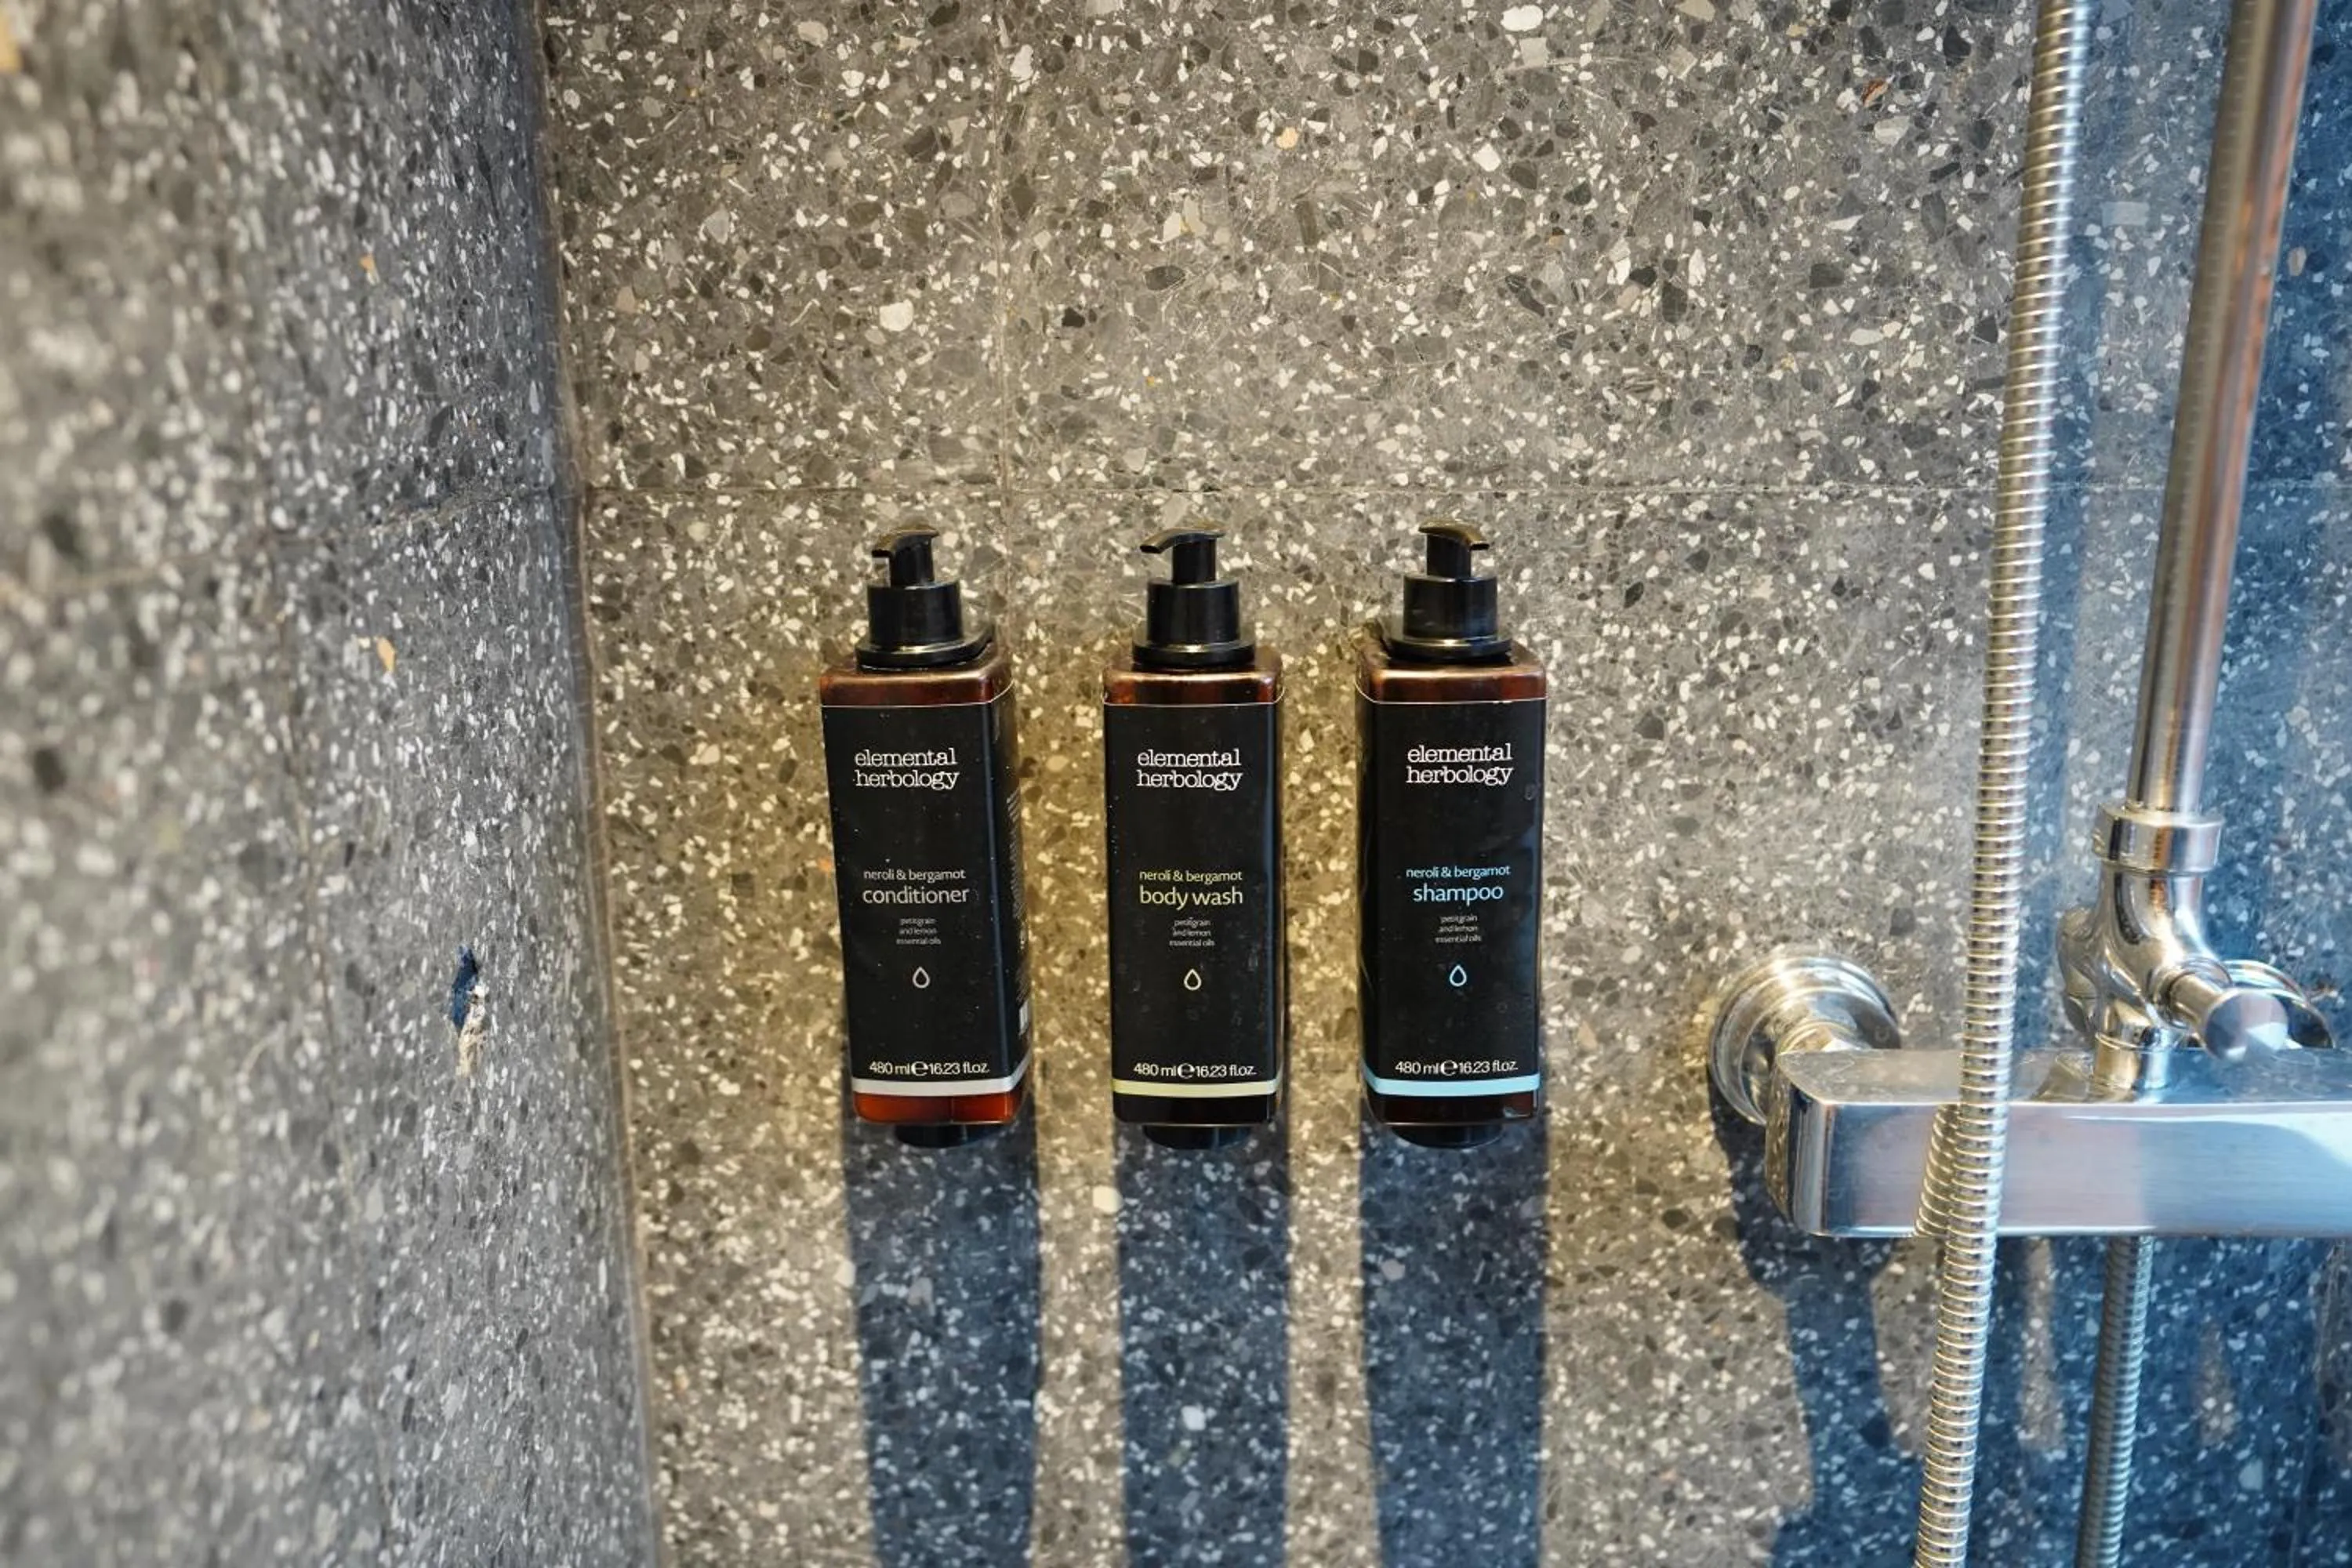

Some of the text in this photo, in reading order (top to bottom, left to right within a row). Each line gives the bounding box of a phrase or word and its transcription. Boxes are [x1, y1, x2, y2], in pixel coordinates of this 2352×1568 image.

[855, 748, 958, 766] elemental
[1138, 748, 1242, 768] elemental
[1407, 742, 1513, 763] elemental
[855, 770, 960, 790] herbology
[1136, 770, 1243, 791] herbology
[1406, 765, 1515, 786] herbology
[864, 869, 966, 884] neroli & bergamot
[1139, 869, 1243, 884] neroli & bergamot
[1406, 865, 1511, 880] neroli & bergamot
[862, 886, 969, 904] conditioner
[1139, 886, 1243, 910] body wash
[1413, 883, 1504, 907] shampoo
[869, 1061, 893, 1074] 480
[895, 1062, 910, 1075] ml
[1134, 1062, 1159, 1076] 480
[1160, 1065, 1177, 1076] ml
[1396, 1061, 1421, 1074] 480
[1423, 1062, 1439, 1074] ml
